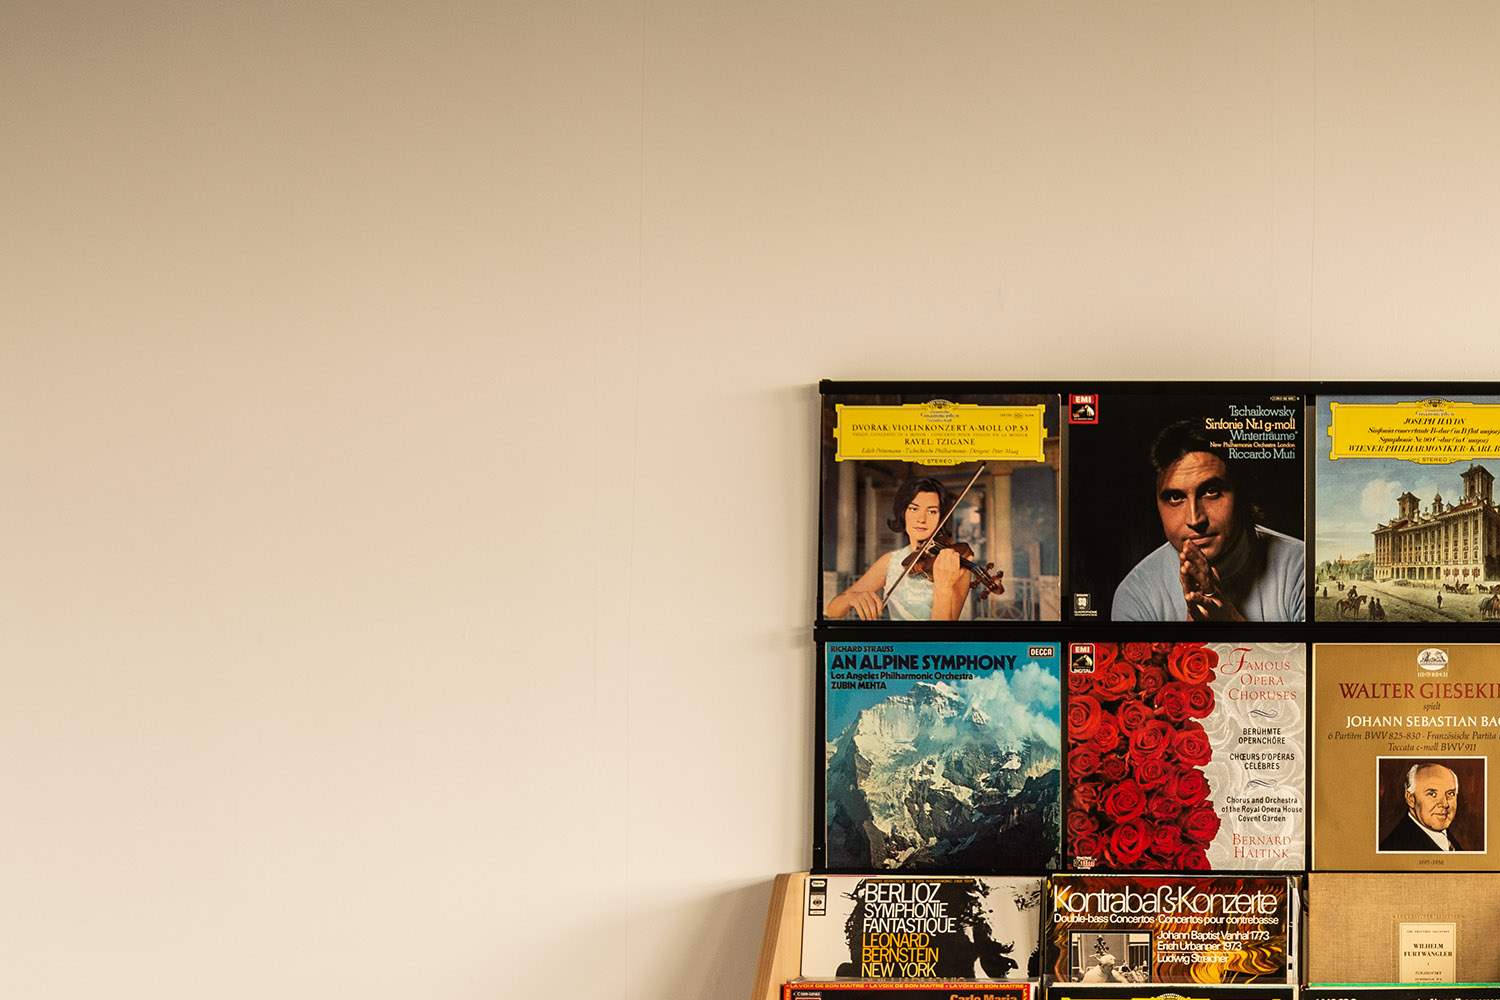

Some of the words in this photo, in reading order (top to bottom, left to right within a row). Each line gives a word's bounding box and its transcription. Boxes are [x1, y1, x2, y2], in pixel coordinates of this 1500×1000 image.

[1229, 405, 1295, 418] Tschaikowsky
[892, 424, 967, 432] VIOLINKONZERT
[1205, 418, 1243, 429] Sinfonie
[1265, 418, 1295, 432] g-moll
[1229, 448, 1271, 459] Riccardo
[1273, 448, 1295, 459] Muti
[1031, 648, 1052, 656] DECCA
[831, 655, 856, 670] AN
[860, 655, 919, 670] ALPINE
[923, 655, 1017, 670] SYMPHONY
[1220, 648, 1290, 675] FAMOUS
[831, 672, 844, 680] Los
[846, 672, 878, 681] Angeles
[881, 672, 933, 680] Philharmonic
[935, 672, 972, 680] Orchestra
[1240, 673, 1284, 685] OPERA
[1229, 688, 1296, 700] CHORUSES
[1339, 683, 1414, 698] WALTER
[1423, 702, 1440, 711] spielt
[1346, 716, 1402, 728] JOHANN
[1406, 716, 1477, 726] SEBASTIAN
[1243, 727, 1281, 735] BERÜHMTE
[1233, 833, 1291, 845] BERNARD
[1234, 847, 1288, 858] HAITINK
[864, 883, 941, 903] BERLIOZ
[1054, 885, 1277, 914] Kontrabaß-Konzerte
[863, 903, 948, 917] SYMPHONIE
[1054, 915, 1108, 923] Double-bass
[1110, 915, 1155, 923] Concertos
[1158, 916, 1203, 924] Concertos
[1204, 916, 1225, 925] pour
[1226, 916, 1279, 924] contrebasse
[863, 918, 957, 936] FANTASTIQUE
[862, 933, 929, 948] LEONARD
[862, 949, 939, 962] BERNSTEIN
[1157, 954, 1190, 964] Ludwig
[1191, 954, 1228, 963] Streicher
[861, 963, 895, 977] NEW
[899, 963, 936, 977] YORK
